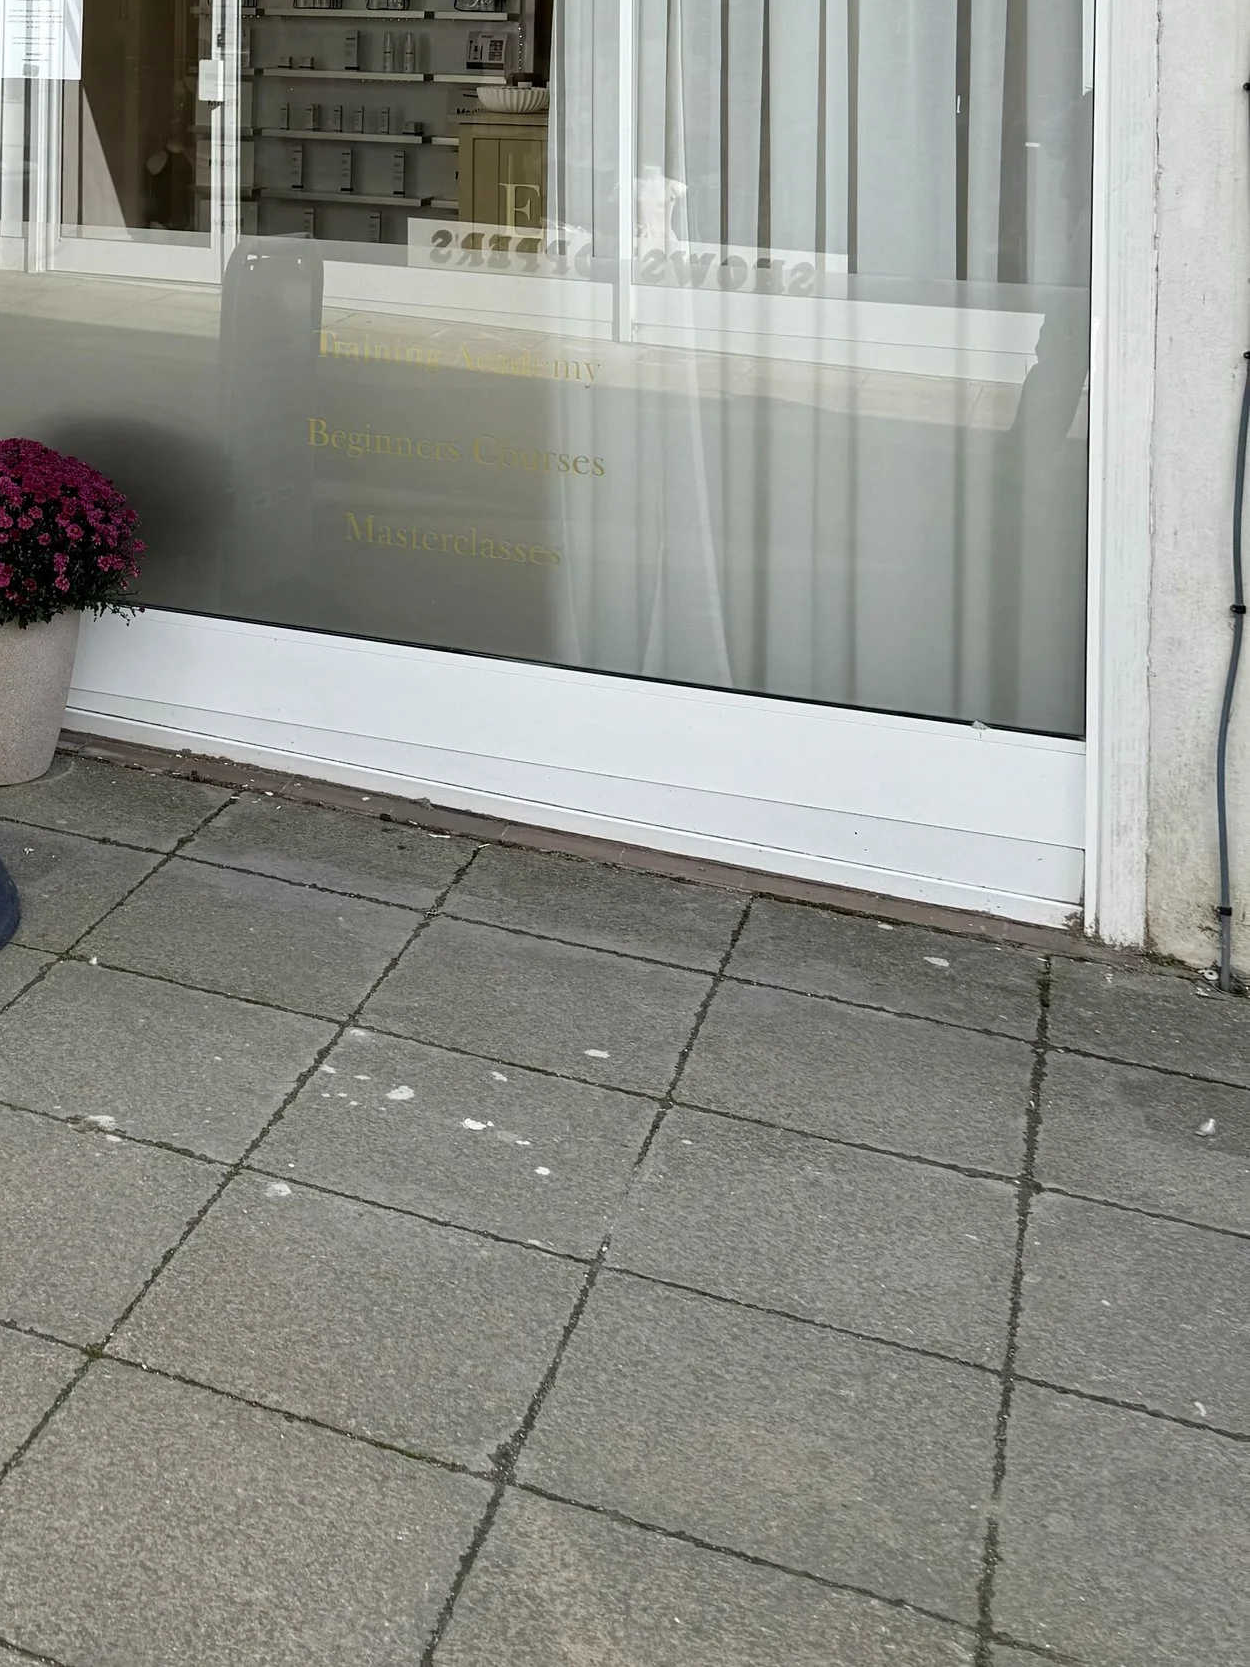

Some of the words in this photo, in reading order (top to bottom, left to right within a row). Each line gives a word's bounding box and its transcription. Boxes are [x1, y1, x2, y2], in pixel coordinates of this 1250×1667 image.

[307, 417, 461, 460] Beginners
[472, 435, 606, 478] Courses
[344, 511, 562, 570] Masterclasses
